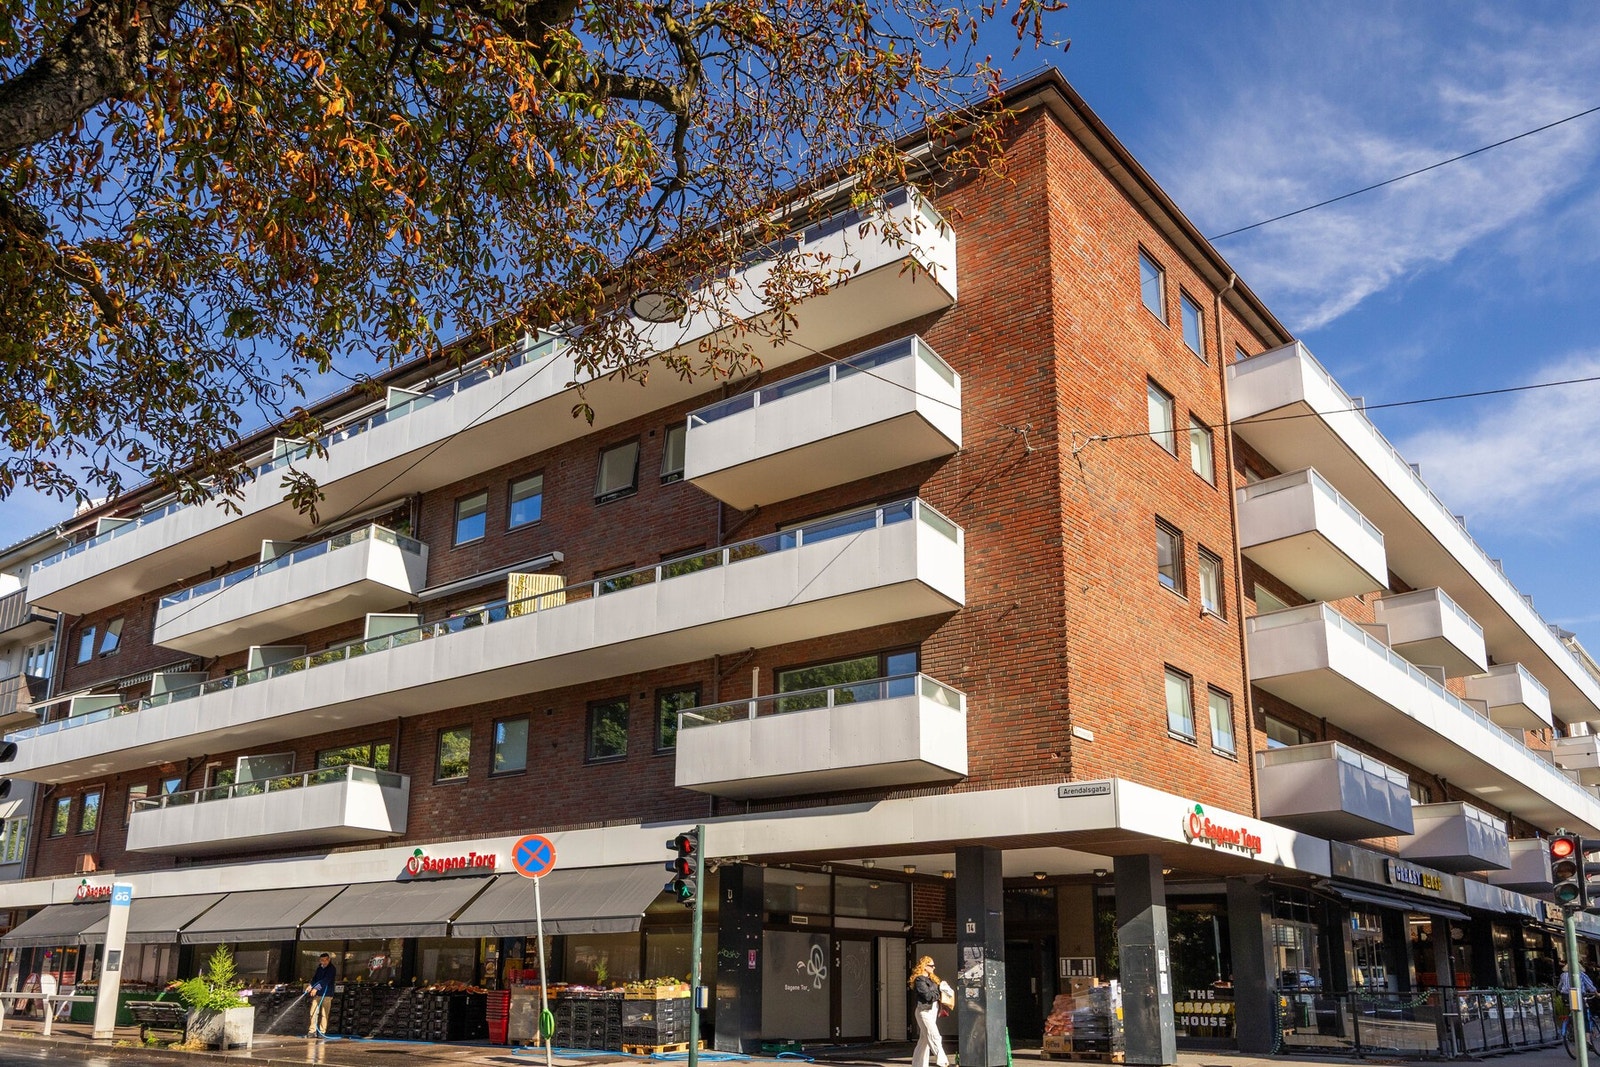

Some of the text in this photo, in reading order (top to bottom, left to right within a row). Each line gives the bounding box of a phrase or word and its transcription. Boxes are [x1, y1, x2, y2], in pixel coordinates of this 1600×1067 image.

[1063, 786, 1107, 796] Arendalsgata
[1204, 817, 1262, 855] Sagene Torg
[422, 851, 496, 874] Sagene Torg
[1395, 865, 1421, 886] GREASY
[86, 884, 111, 899] Sagene
[1187, 989, 1215, 1000] THE
[1174, 1001, 1231, 1015] GREASY
[1180, 1015, 1227, 1027] HOUSE
